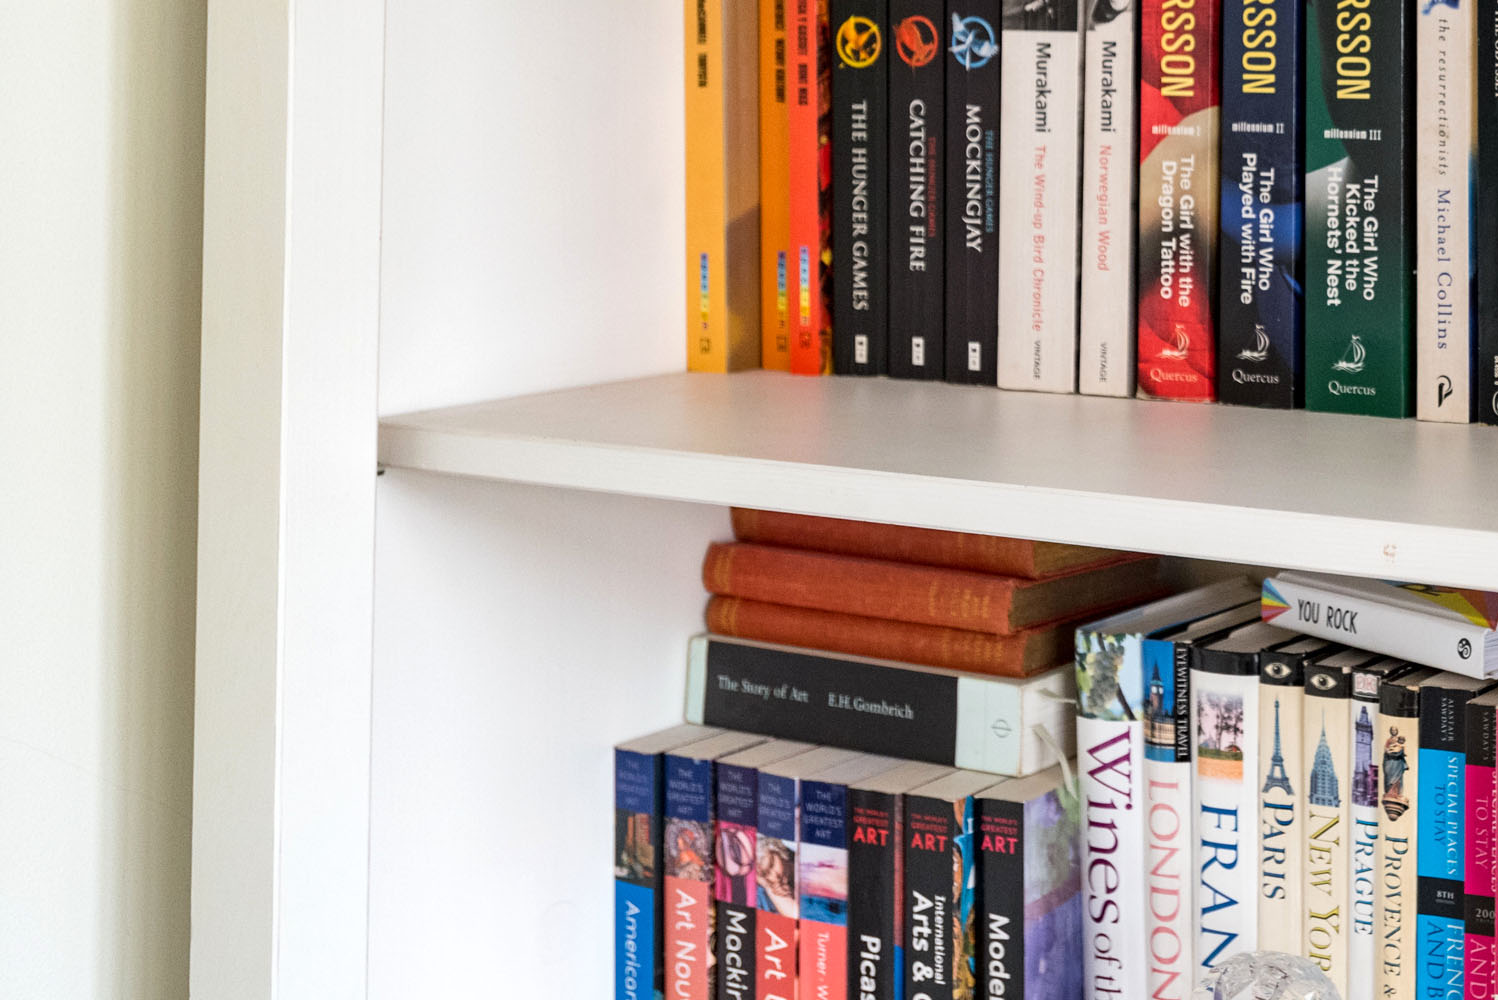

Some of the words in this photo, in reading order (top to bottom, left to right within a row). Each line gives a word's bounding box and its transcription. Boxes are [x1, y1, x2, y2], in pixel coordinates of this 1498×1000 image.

[850, 100, 867, 140] THE
[1035, 42, 1052, 133] Murakami
[1100, 41, 1117, 133] Murakami
[850, 146, 867, 239] HUNGER
[908, 100, 926, 219] CATCHING
[961, 104, 982, 254] MOCKINGJAY
[1239, 153, 1257, 219] Played
[1158, 160, 1177, 232] Dragon
[1437, 189, 1451, 262] Michael
[852, 242, 869, 312] GAMES
[909, 224, 926, 272] FIRE
[1160, 238, 1177, 299] Tattoo
[1241, 223, 1256, 264] with
[1241, 268, 1255, 305] Fire
[1327, 259, 1342, 307] Nest
[1437, 272, 1453, 349] Collins
[1328, 380, 1376, 397] Quercus
[1298, 599, 1319, 624] YOU
[1326, 606, 1358, 634] ROCK
[854, 827, 889, 847] ART
[1086, 726, 1134, 924] Wines
[1262, 802, 1294, 900] PARIS
[1149, 780, 1181, 1000] LONDON
[1354, 818, 1379, 936] PRAGUE
[1383, 834, 1408, 977] PROVENCE
